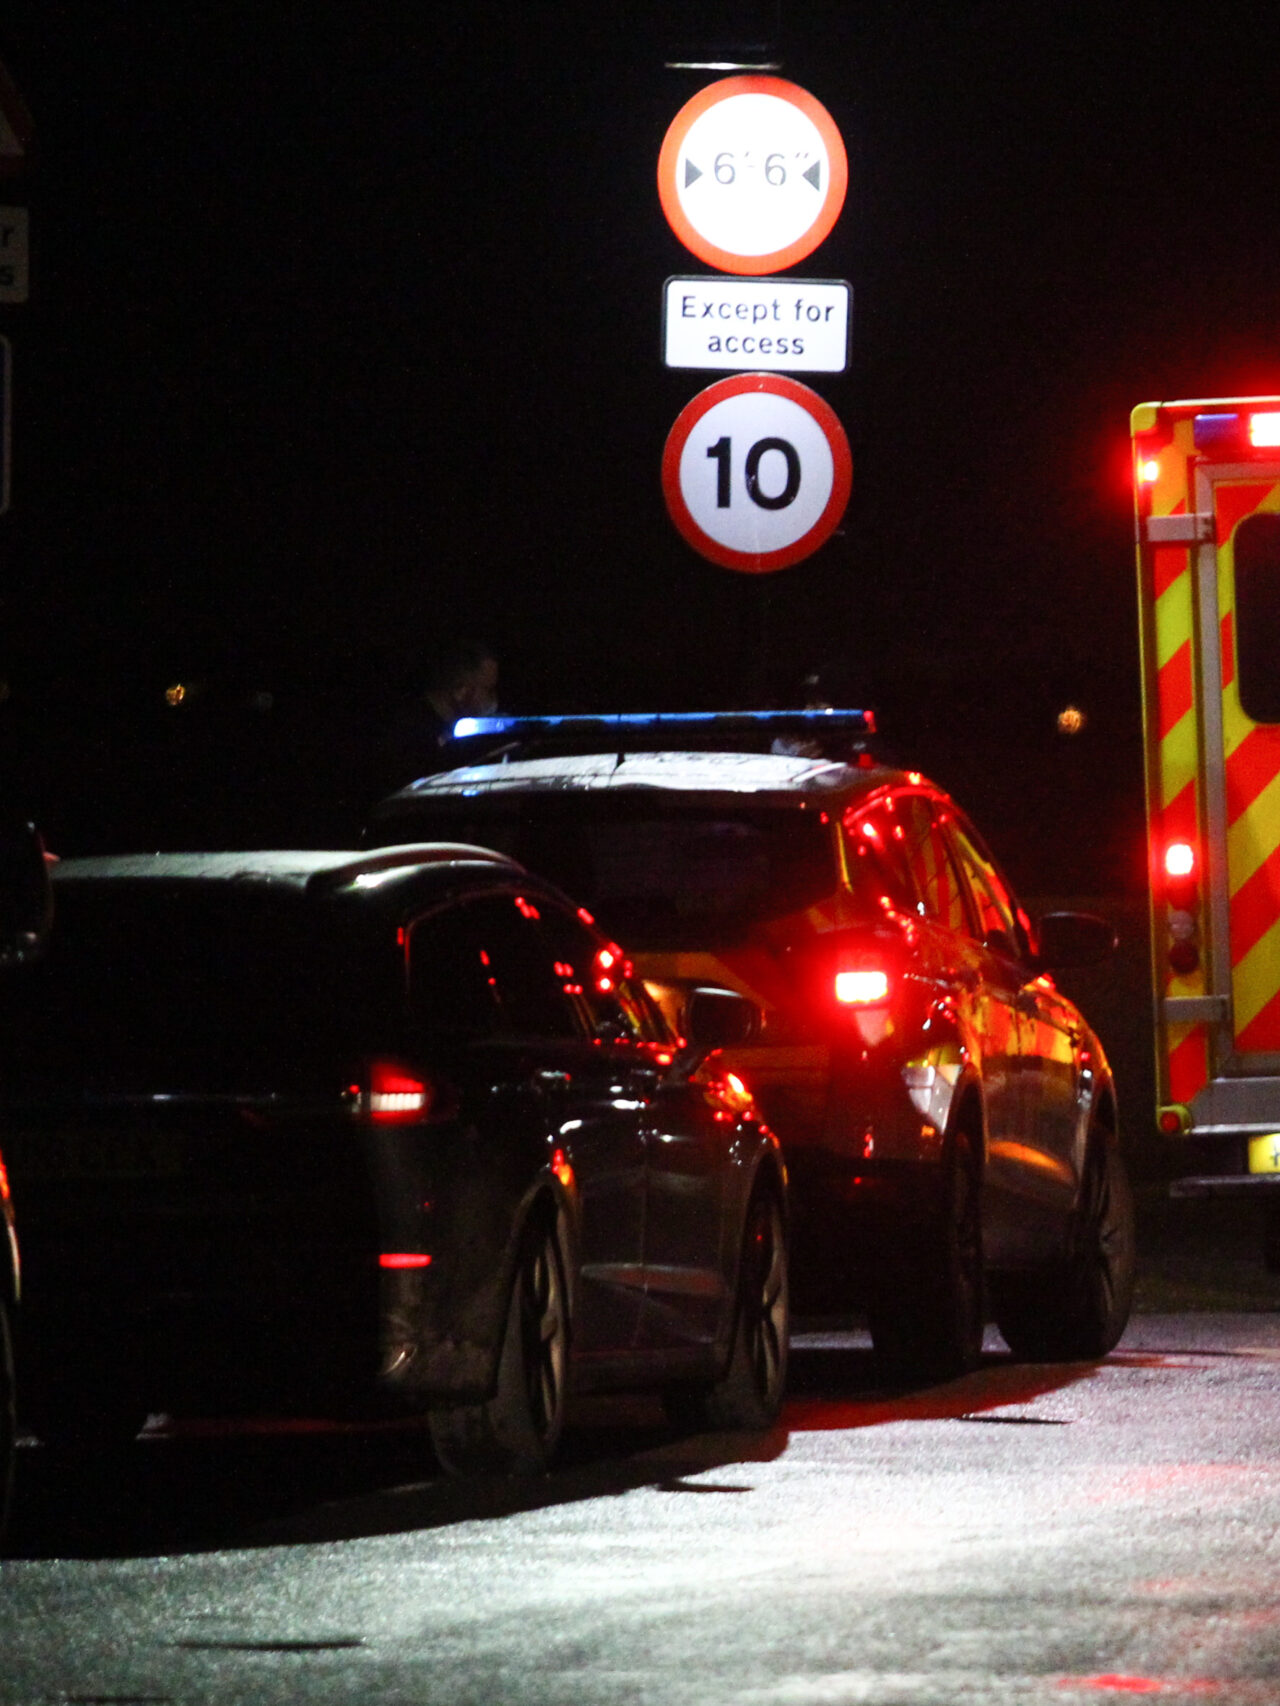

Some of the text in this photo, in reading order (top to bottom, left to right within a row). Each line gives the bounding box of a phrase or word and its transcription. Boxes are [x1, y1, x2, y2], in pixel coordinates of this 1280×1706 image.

[681, 295, 835, 324] Except for
[707, 335, 805, 355] access
[706, 436, 802, 511] 10
